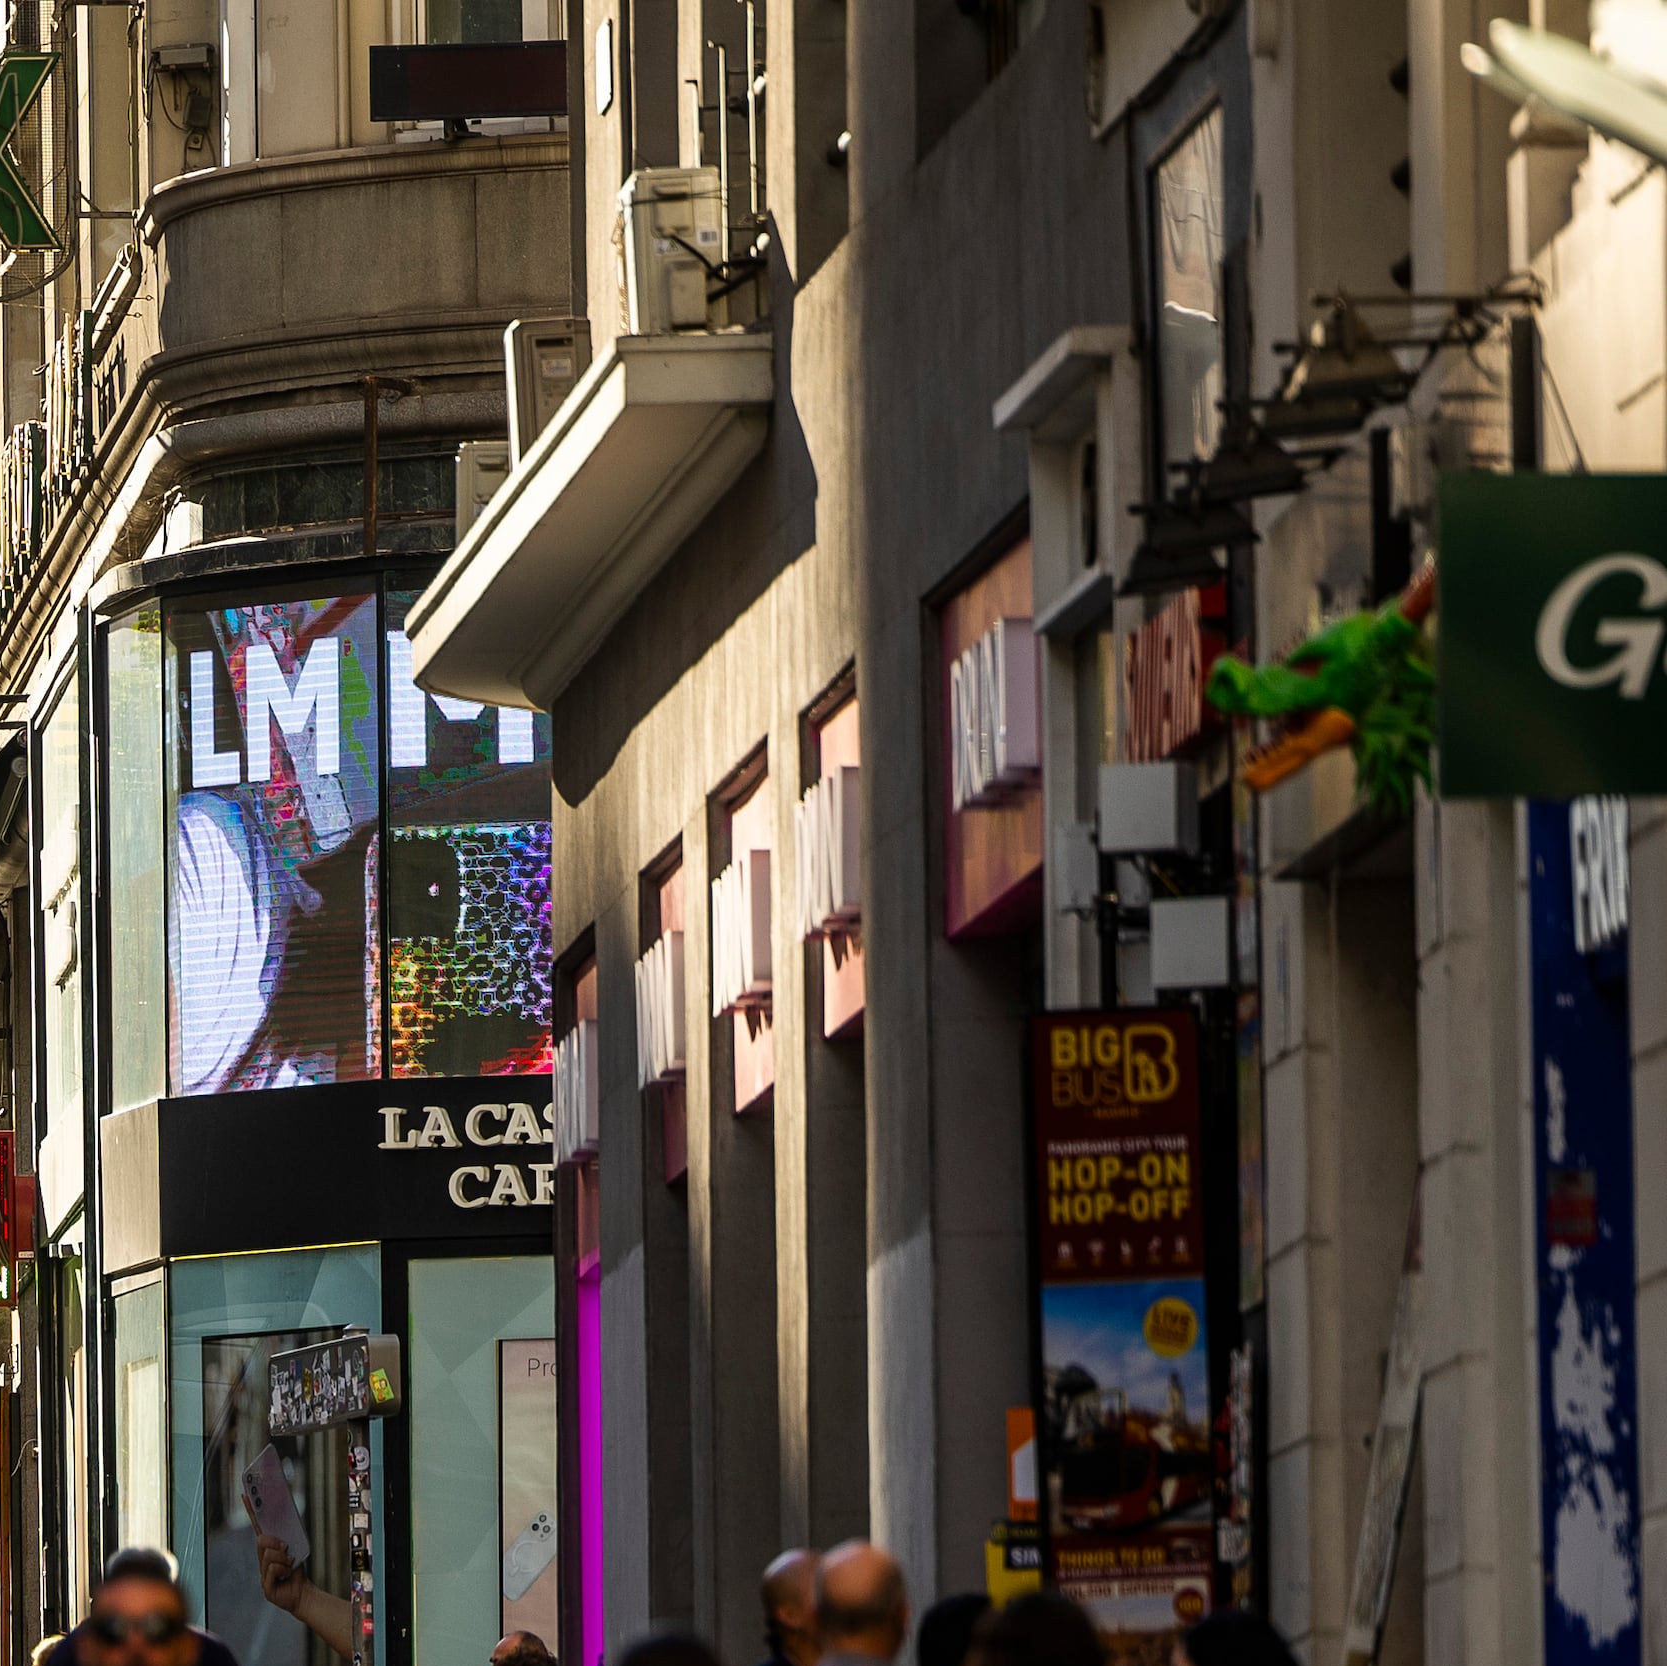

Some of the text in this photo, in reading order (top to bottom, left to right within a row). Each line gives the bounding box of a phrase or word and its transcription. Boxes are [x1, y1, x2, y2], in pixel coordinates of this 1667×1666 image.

[1051, 1026, 1119, 1069] BIG
[1051, 1069, 1120, 1106] BUS
[378, 1105, 463, 1149] LA
[1047, 1152, 1191, 1191] HOP-ON
[1047, 1188, 1192, 1225] HOP-OFF
